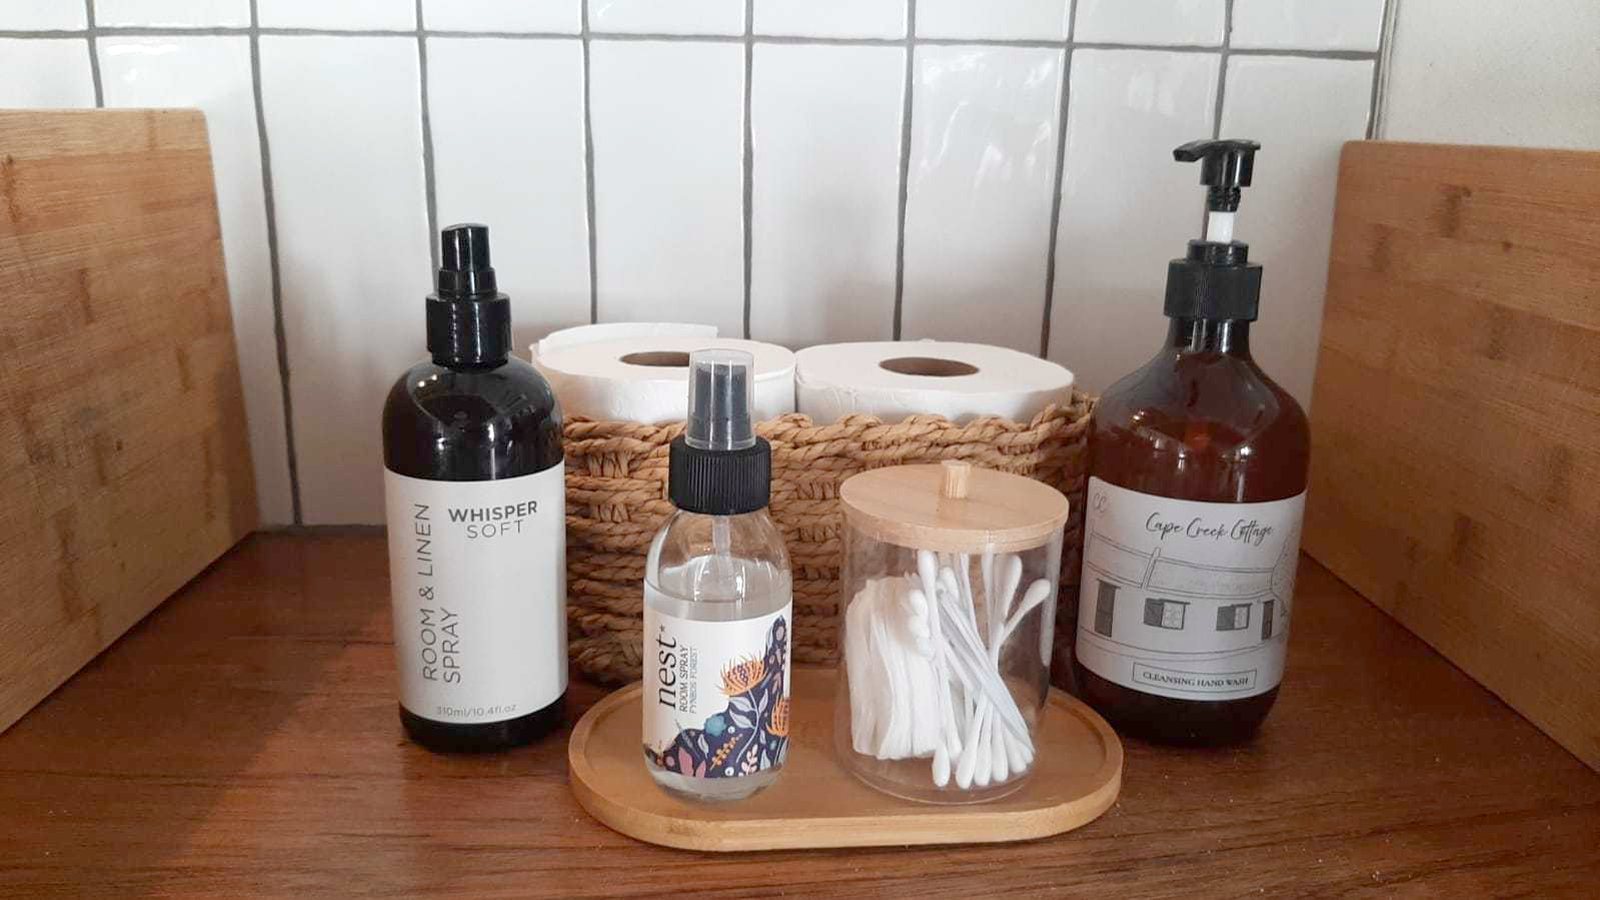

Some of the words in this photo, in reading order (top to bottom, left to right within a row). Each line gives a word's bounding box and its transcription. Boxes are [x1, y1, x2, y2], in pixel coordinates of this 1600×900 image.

[448, 500, 537, 522] WHISPER
[414, 503, 433, 576] LINEN
[466, 519, 524, 539] SOFT
[1145, 511, 1183, 541] Cape
[1186, 517, 1227, 539] Creek
[1230, 519, 1274, 547] Cottage
[418, 585, 434, 600] &
[420, 608, 438, 681] ROOM
[440, 606, 461, 683] SPRAY
[656, 633, 677, 710] nest
[679, 645, 688, 680] SPRAY
[1142, 671, 1196, 687] CLEANSING
[1196, 679, 1224, 687] HAND
[679, 682, 688, 713] ROOM
